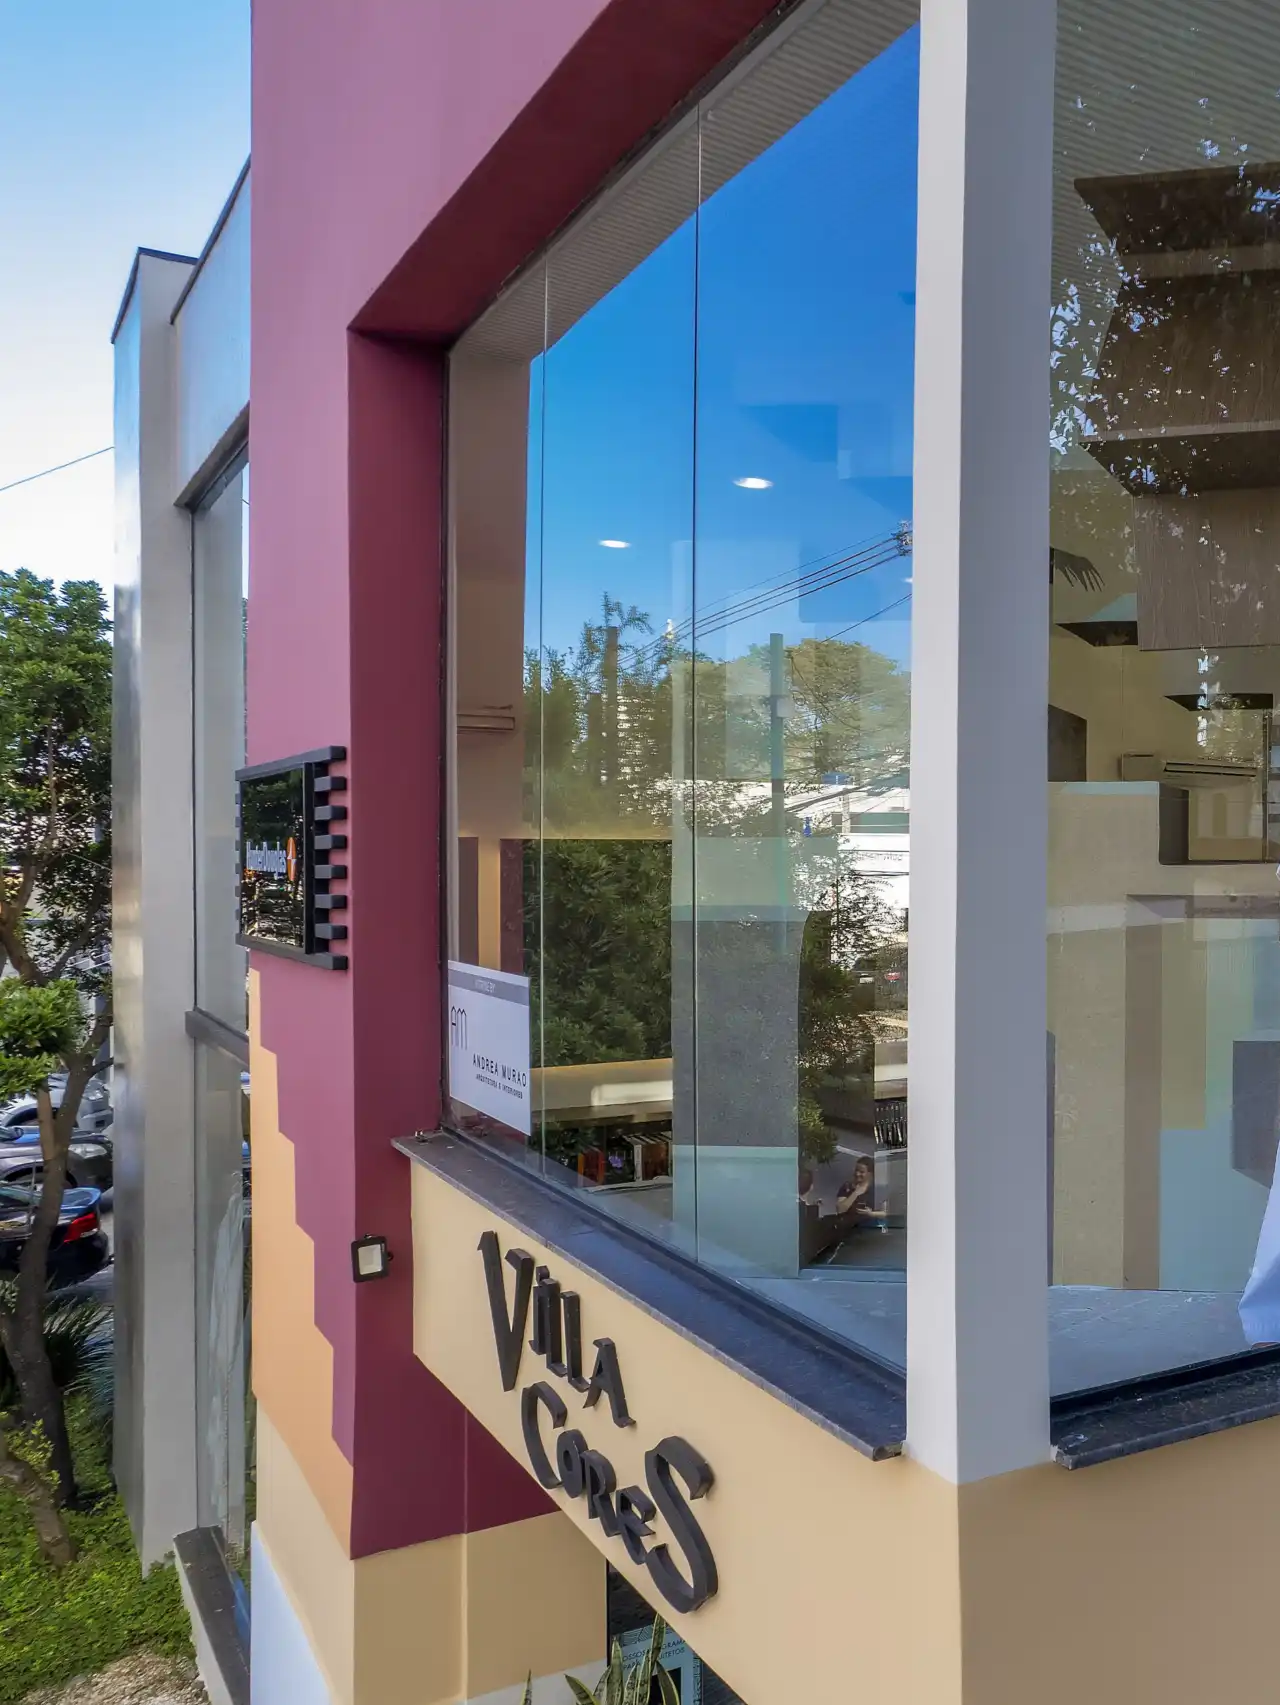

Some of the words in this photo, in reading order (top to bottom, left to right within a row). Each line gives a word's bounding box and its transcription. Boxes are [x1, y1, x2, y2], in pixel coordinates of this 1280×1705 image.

[451, 1006, 468, 1050] AM
[473, 1053, 499, 1077] ANDREA
[501, 1064, 527, 1087] MURAO
[623, 1649, 646, 1662] OSSOS
